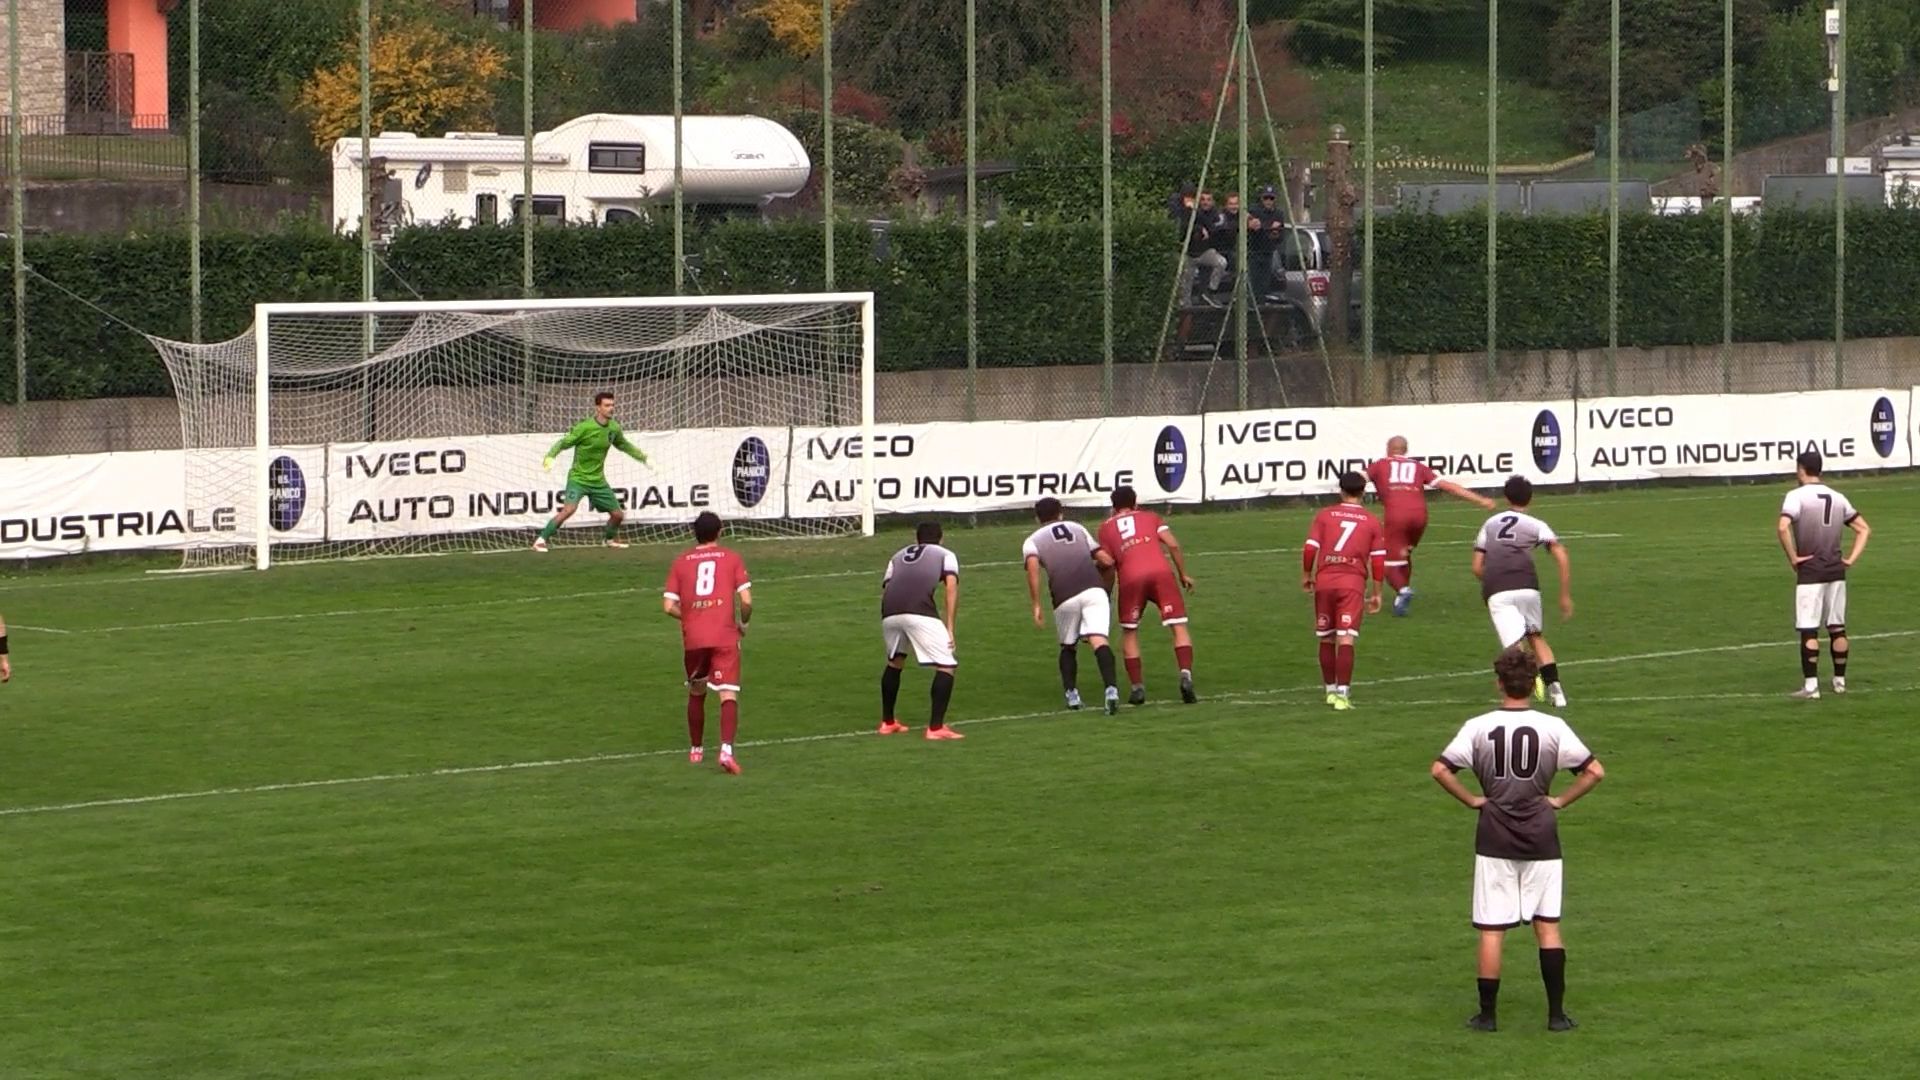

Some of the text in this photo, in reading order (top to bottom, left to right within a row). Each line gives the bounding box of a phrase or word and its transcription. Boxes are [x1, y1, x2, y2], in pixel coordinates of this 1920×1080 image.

[1218, 420, 1317, 445] IVECO
[1589, 406, 1673, 429] IVECO
[346, 449, 466, 478] IVECO
[1591, 437, 1855, 467] AUTO INDUSTRIALE
[1221, 453, 1513, 486] AUTO INDRIALE
[1388, 460, 1417, 484] 10
[806, 470, 1133, 503] AUO INDUSTRIALE
[348, 484, 711, 524] AUTO INDURIALE
[1816, 493, 1833, 525] 7
[0, 507, 236, 544] DUSTRIALE
[1116, 515, 1137, 540] 9
[1333, 520, 1358, 552] 7
[1497, 515, 1519, 540] 2
[902, 544, 928, 564] 9
[695, 560, 717, 597] 8
[1487, 724, 1541, 780] 10
